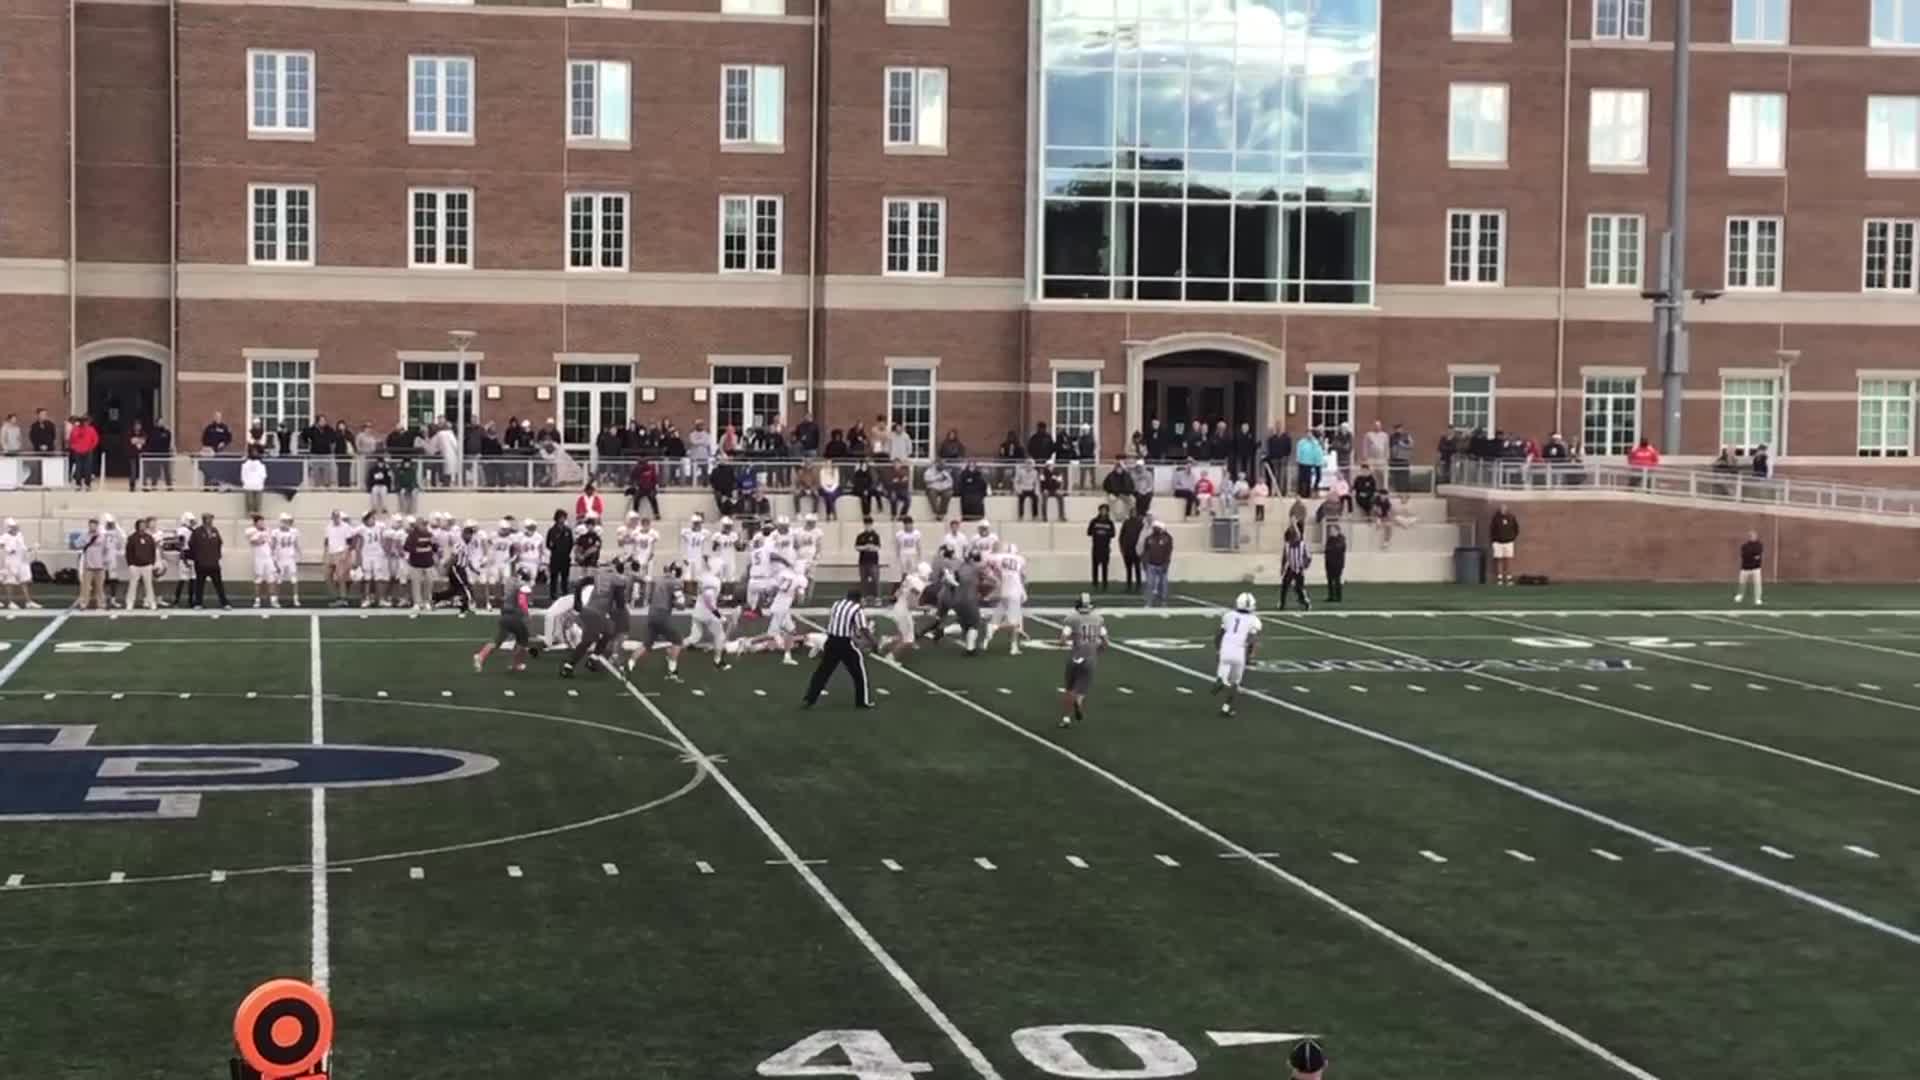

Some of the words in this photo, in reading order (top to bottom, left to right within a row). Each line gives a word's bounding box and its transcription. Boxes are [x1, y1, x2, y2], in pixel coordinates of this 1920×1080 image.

[753, 552, 762, 566] 5
[1233, 617, 1240, 633] 1
[756, 1023, 1199, 1080] 40
